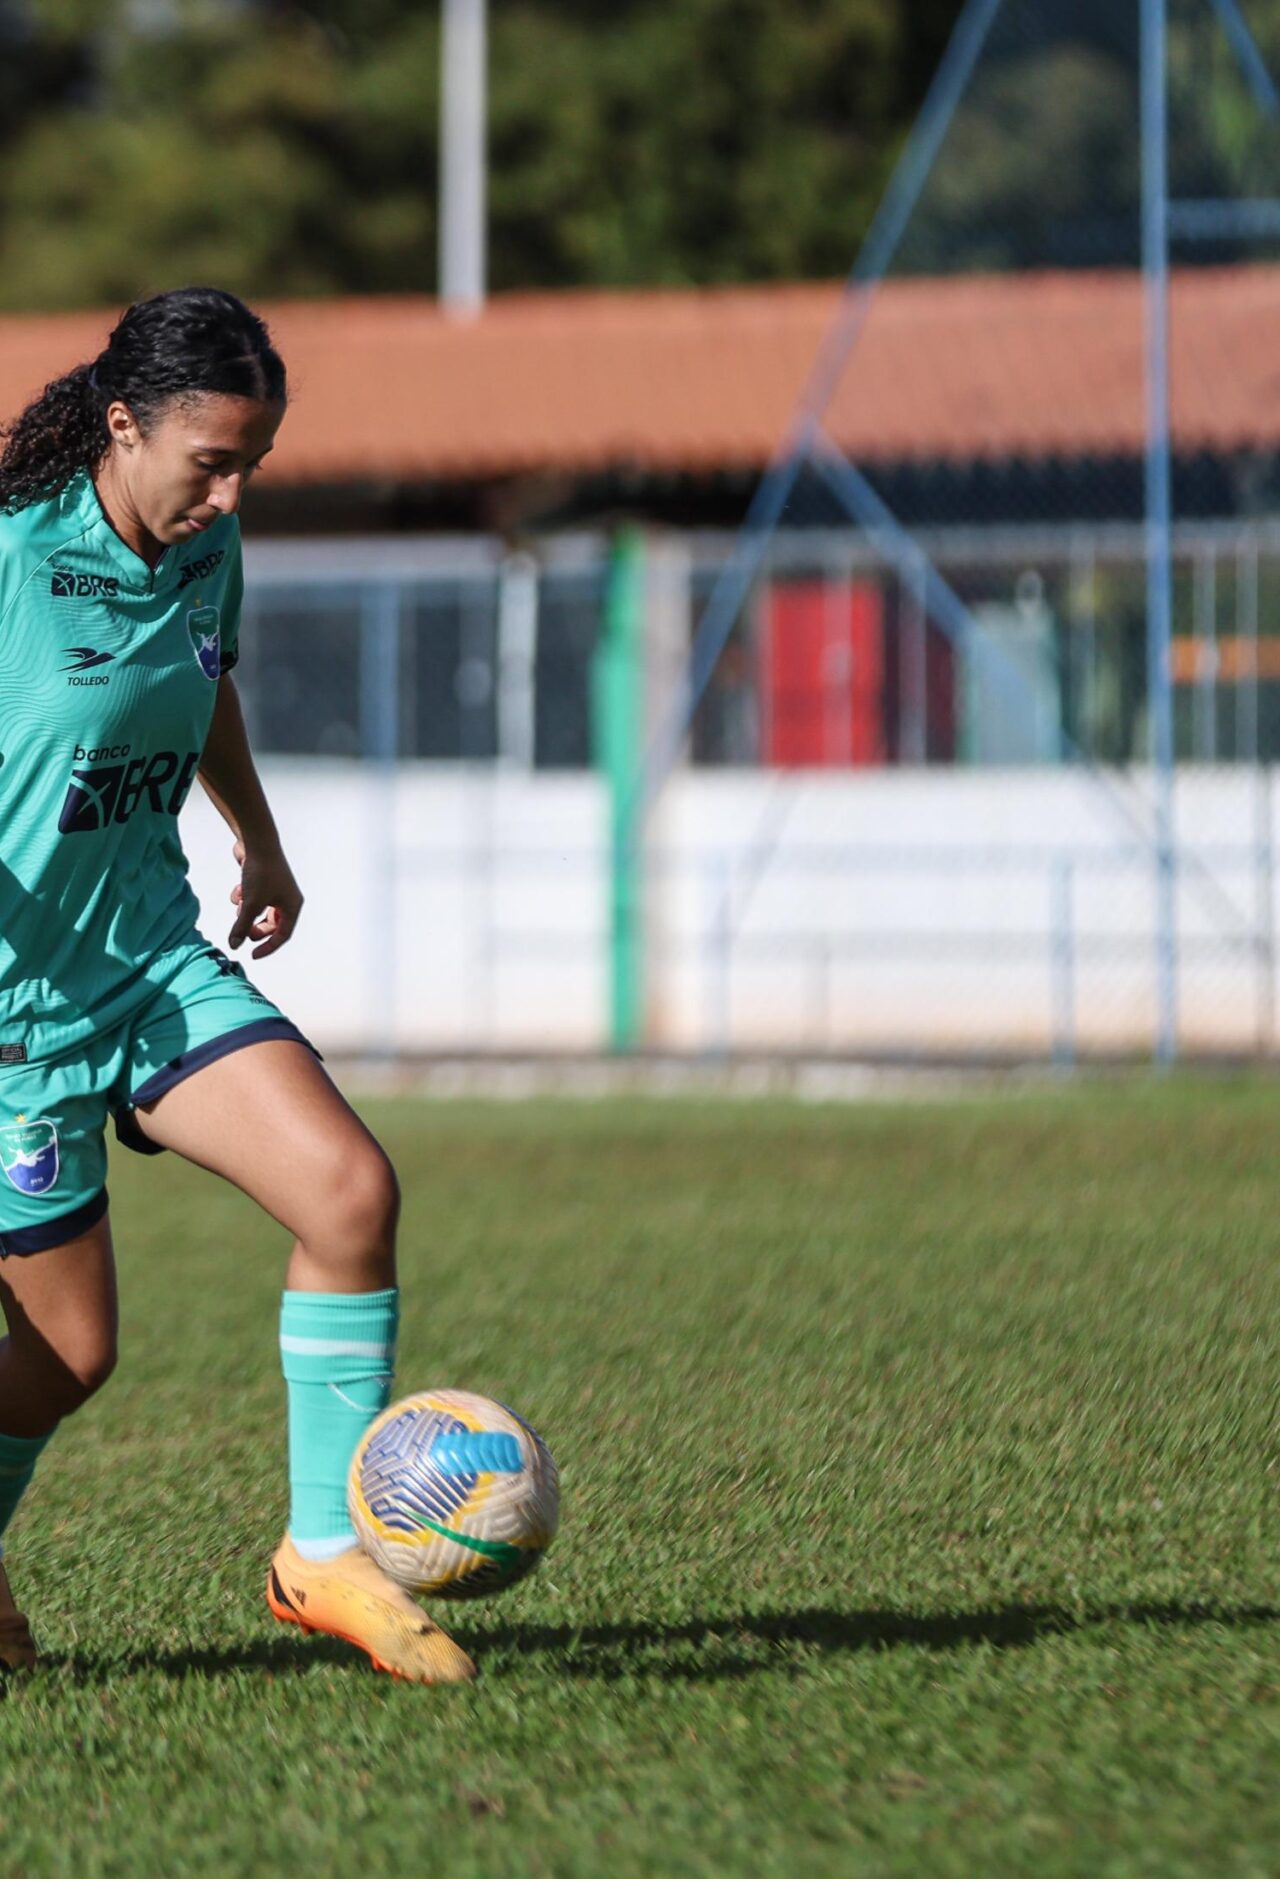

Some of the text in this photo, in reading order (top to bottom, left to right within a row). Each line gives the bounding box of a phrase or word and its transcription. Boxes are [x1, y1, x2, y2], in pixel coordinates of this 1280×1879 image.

[76, 575, 119, 597] BRB
[67, 675, 110, 686] TOLLEDO
[72, 743, 132, 762] banco
